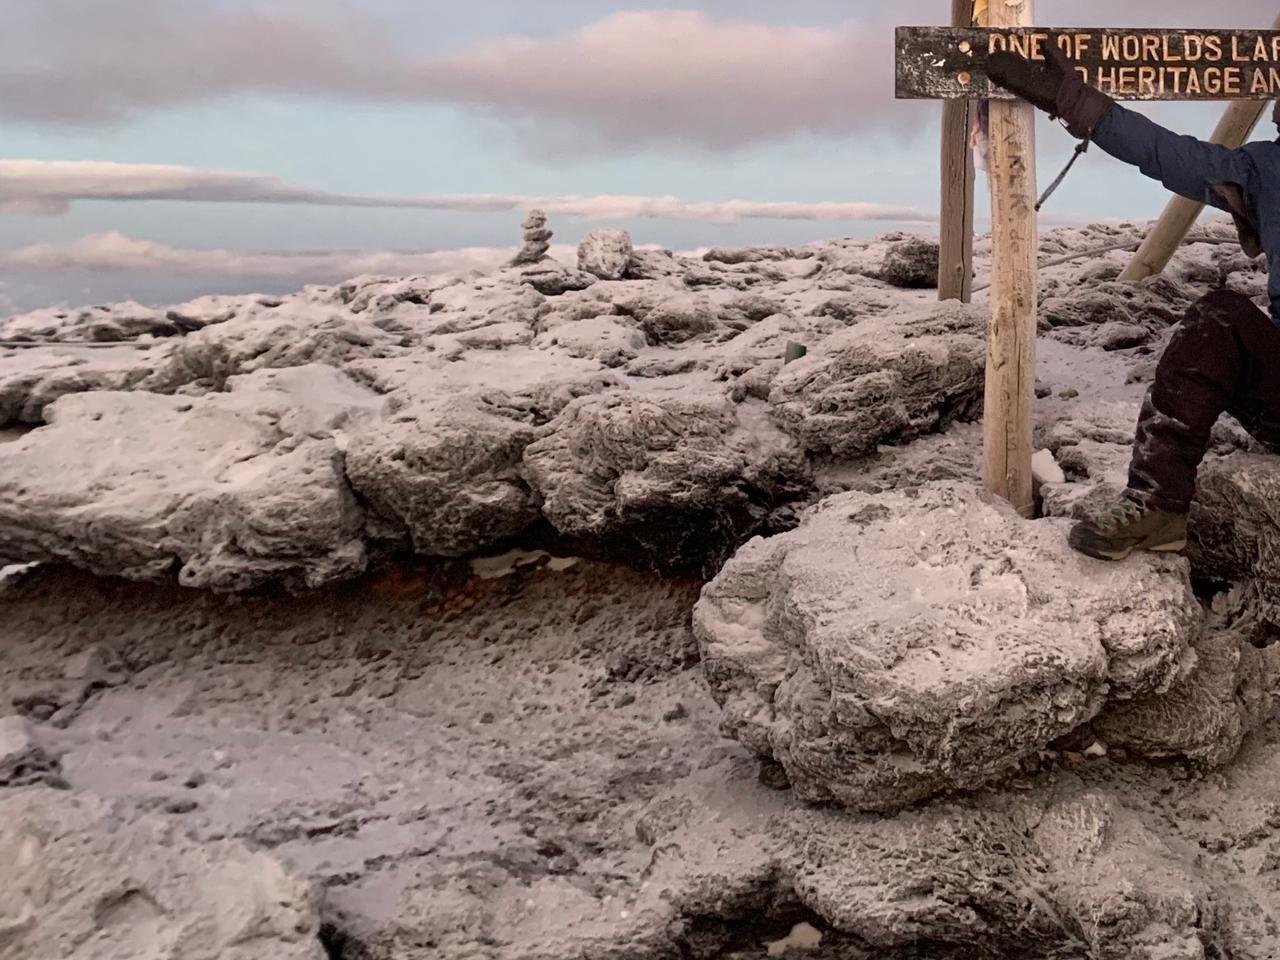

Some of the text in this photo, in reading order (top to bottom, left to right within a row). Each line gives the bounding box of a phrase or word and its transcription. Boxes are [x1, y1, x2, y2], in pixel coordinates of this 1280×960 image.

[988, 33, 1049, 61] ONE
[1057, 34, 1093, 60] OF
[1101, 34, 1223, 62] WORLD'S
[1097, 66, 1242, 95] HERITAGE
